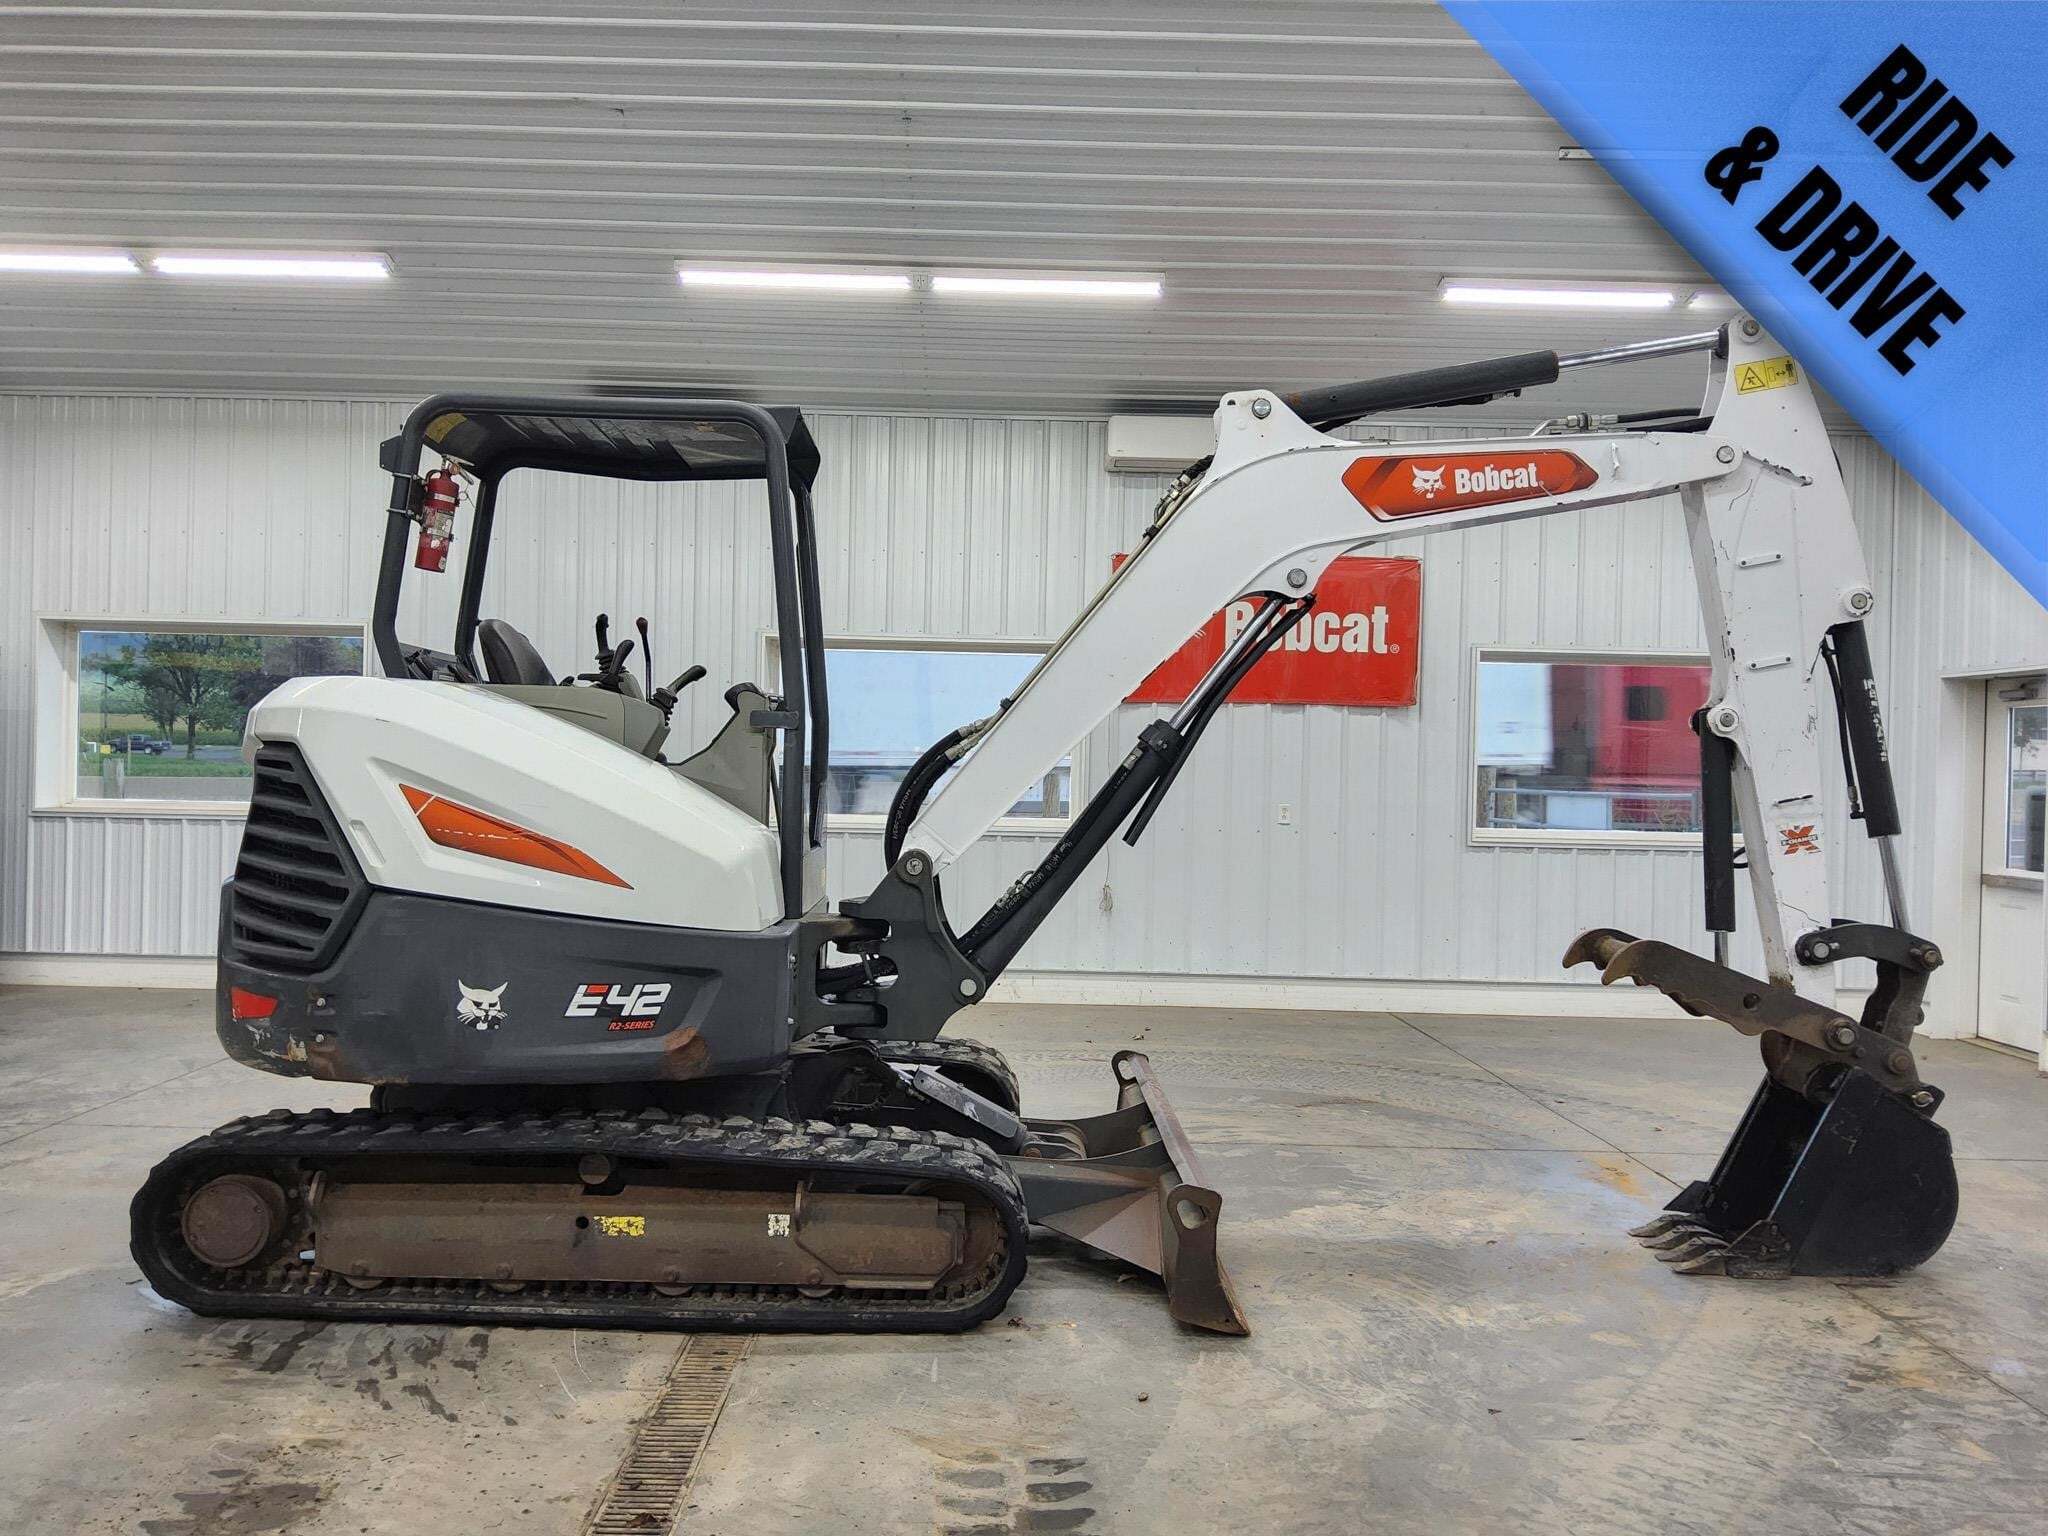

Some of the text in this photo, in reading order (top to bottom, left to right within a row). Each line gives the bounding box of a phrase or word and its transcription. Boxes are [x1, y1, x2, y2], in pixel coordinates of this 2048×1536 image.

[1454, 462, 1539, 495] Bobcat
[564, 983, 672, 1017] E42
[608, 1020, 656, 1031] R2-SERIES
